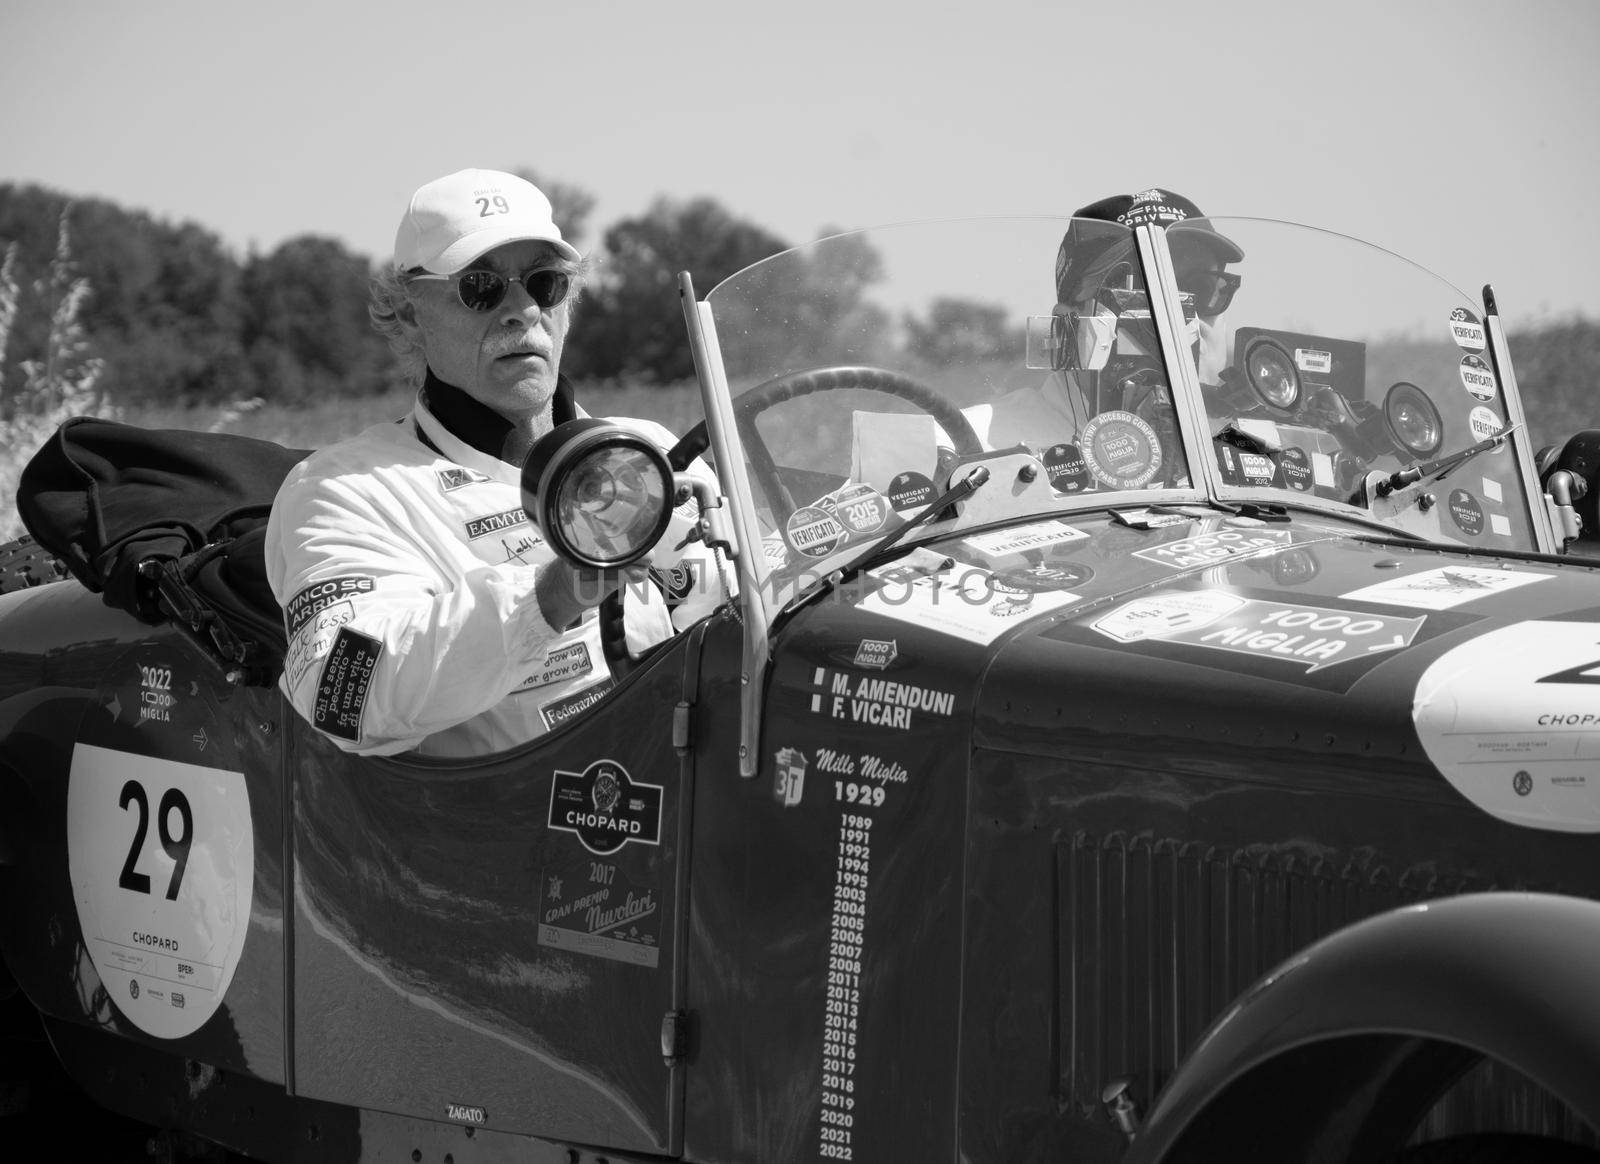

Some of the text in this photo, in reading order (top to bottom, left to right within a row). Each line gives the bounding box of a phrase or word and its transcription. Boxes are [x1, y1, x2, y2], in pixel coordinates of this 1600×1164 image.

[475, 195, 510, 217] 29
[1116, 205, 1187, 223] OFFICIAL
[1452, 326, 1483, 341] VERIFICATO
[1463, 371, 1494, 388] VERIFICATO
[1098, 412, 1132, 425] ACCESSO
[1472, 419, 1502, 437] VERIFICA
[1106, 438, 1128, 450] 1000
[1109, 446, 1134, 460] MIGLIA
[1046, 460, 1085, 473] VERIFICATO
[1244, 456, 1266, 465] 1000
[1281, 462, 1311, 474] VERIFICATO
[1245, 466, 1270, 476] MIGLIA
[1254, 477, 1269, 485] 2012
[891, 486, 931, 502] VERIFICATO
[846, 498, 880, 523] 2015
[791, 520, 836, 546] VERIFICATO
[989, 530, 1075, 552] VERIFICATO
[1157, 532, 1243, 557] 1000
[287, 579, 372, 615] VINCO SE
[314, 611, 350, 634] less
[1259, 609, 1385, 636] 1000
[863, 642, 889, 653] 1000
[1200, 627, 1348, 661] MIGLIA
[570, 646, 584, 668] up
[857, 653, 886, 664] MIGLIA
[141, 666, 171, 690] 2022
[315, 698, 328, 723] Chi
[327, 637, 348, 681] senza
[343, 680, 356, 710] una
[350, 650, 366, 678] vita
[522, 656, 590, 687] ver grow old
[329, 656, 349, 713] peccato
[349, 655, 375, 728] di merda
[140, 691, 171, 707] 1000
[831, 673, 955, 716] M. AMENDUNI
[140, 706, 171, 723] MIGLIA
[831, 696, 912, 730] F. VICARI
[1538, 714, 1600, 727] CHOP
[816, 748, 909, 786] Mille Miglia
[834, 781, 886, 807] 1929
[566, 810, 641, 834] CHOPARD
[841, 813, 873, 830] 1989
[117, 779, 194, 901] 29
[840, 828, 870, 845] 1991
[839, 842, 870, 859] 1992
[589, 861, 616, 885] 2017
[837, 856, 869, 874] 1994
[836, 871, 868, 888] 1995
[834, 885, 866, 902] 2003
[545, 889, 609, 923] GRAN PREMIO
[585, 889, 656, 932] Nuvolari
[833, 899, 866, 916] 2004
[832, 914, 864, 931] 2005
[132, 931, 179, 951] CHOPARD
[831, 928, 863, 945] 2006
[830, 942, 862, 959] 2007
[829, 956, 861, 974] 2008
[828, 971, 859, 988] 2011
[827, 985, 859, 1003] 2012
[826, 1000, 858, 1017] 2013
[825, 1014, 857, 1031] 2014
[824, 1028, 856, 1046] 2015
[823, 1043, 856, 1060] 2016
[823, 1058, 855, 1075] 2017
[822, 1073, 854, 1093] 2018
[822, 1092, 854, 1110] 2019
[448, 1105, 483, 1123] ZAGATO
[820, 1109, 853, 1127] 2020
[820, 1127, 851, 1144] 2021
[820, 1143, 852, 1160] 2022
